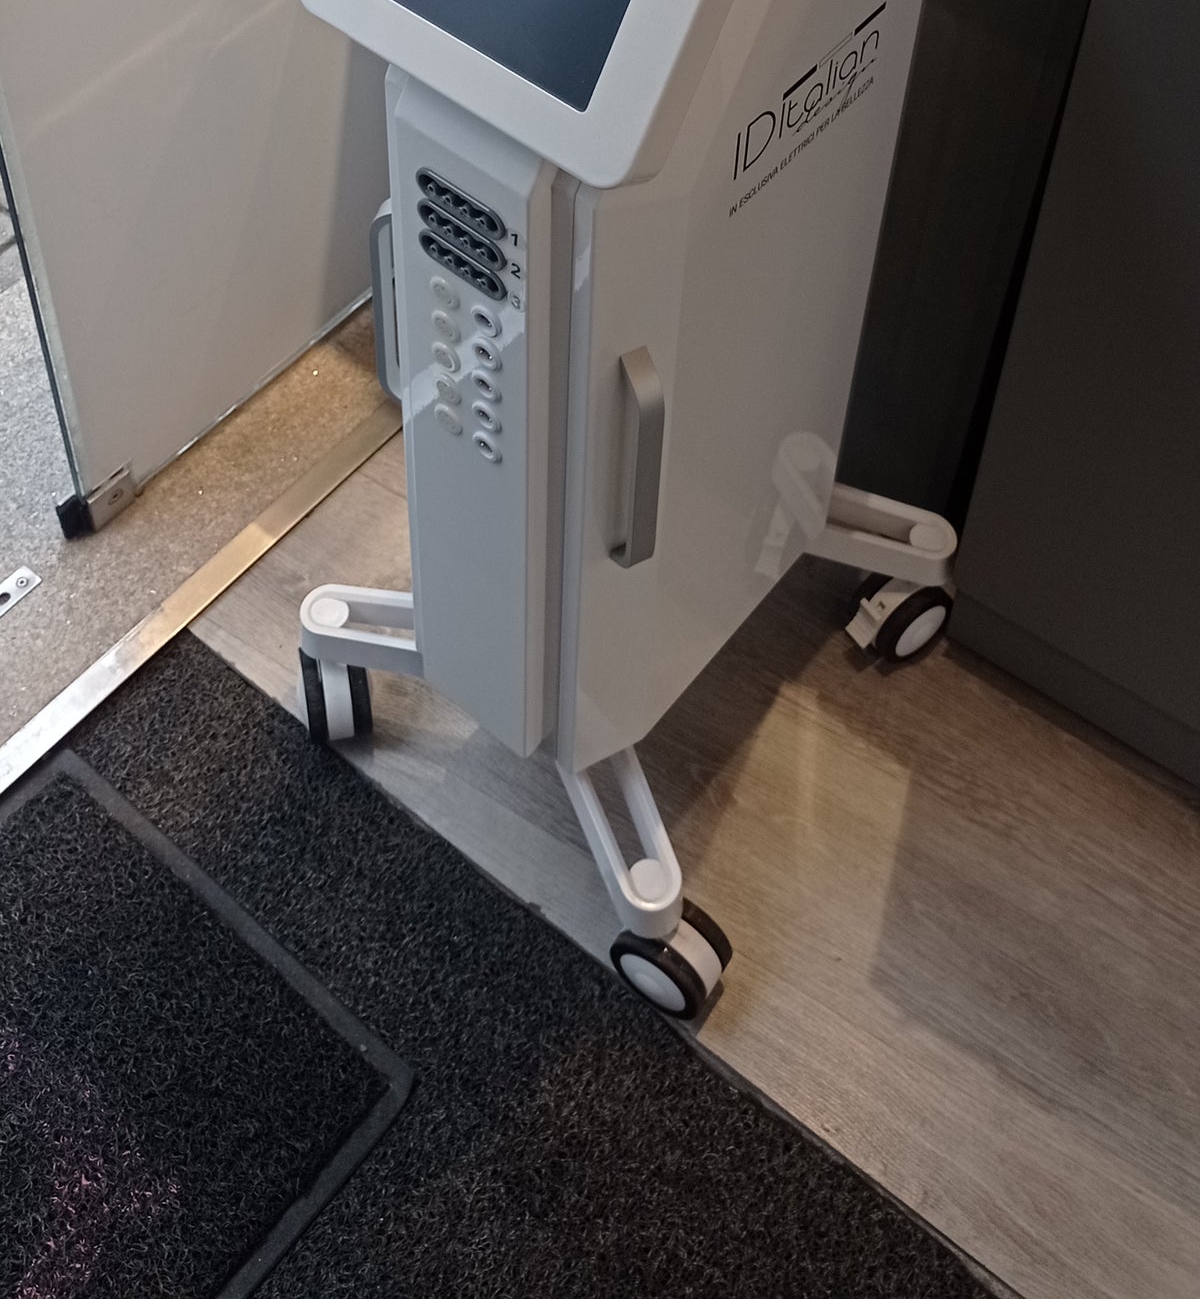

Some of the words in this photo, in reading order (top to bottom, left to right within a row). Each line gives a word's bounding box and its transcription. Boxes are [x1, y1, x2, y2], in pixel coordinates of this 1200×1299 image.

[729, 203, 738, 218] IN
[739, 166, 779, 209] ESCLUSIVA
[511, 233, 519, 247] 1
[511, 263, 521, 279] 2
